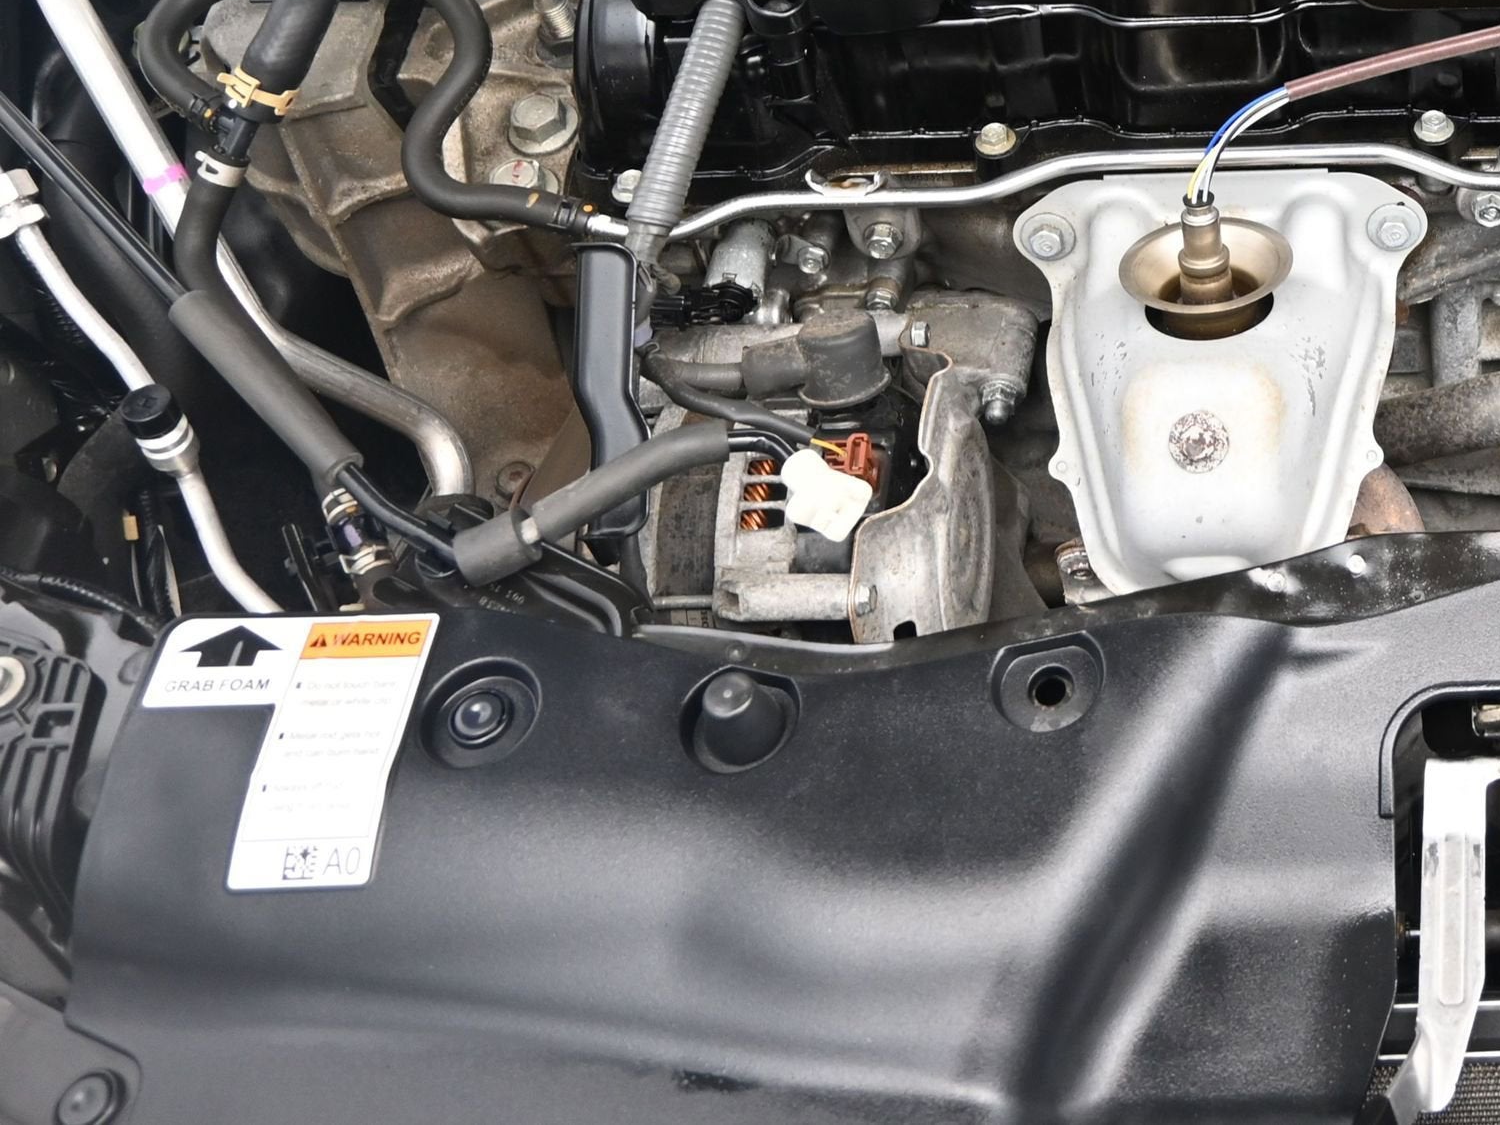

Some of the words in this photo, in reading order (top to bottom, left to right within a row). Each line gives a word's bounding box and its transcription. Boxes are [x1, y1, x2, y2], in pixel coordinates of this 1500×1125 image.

[332, 631, 421, 648] WARNING
[164, 679, 214, 693] GRAB
[218, 678, 270, 691] FOAM
